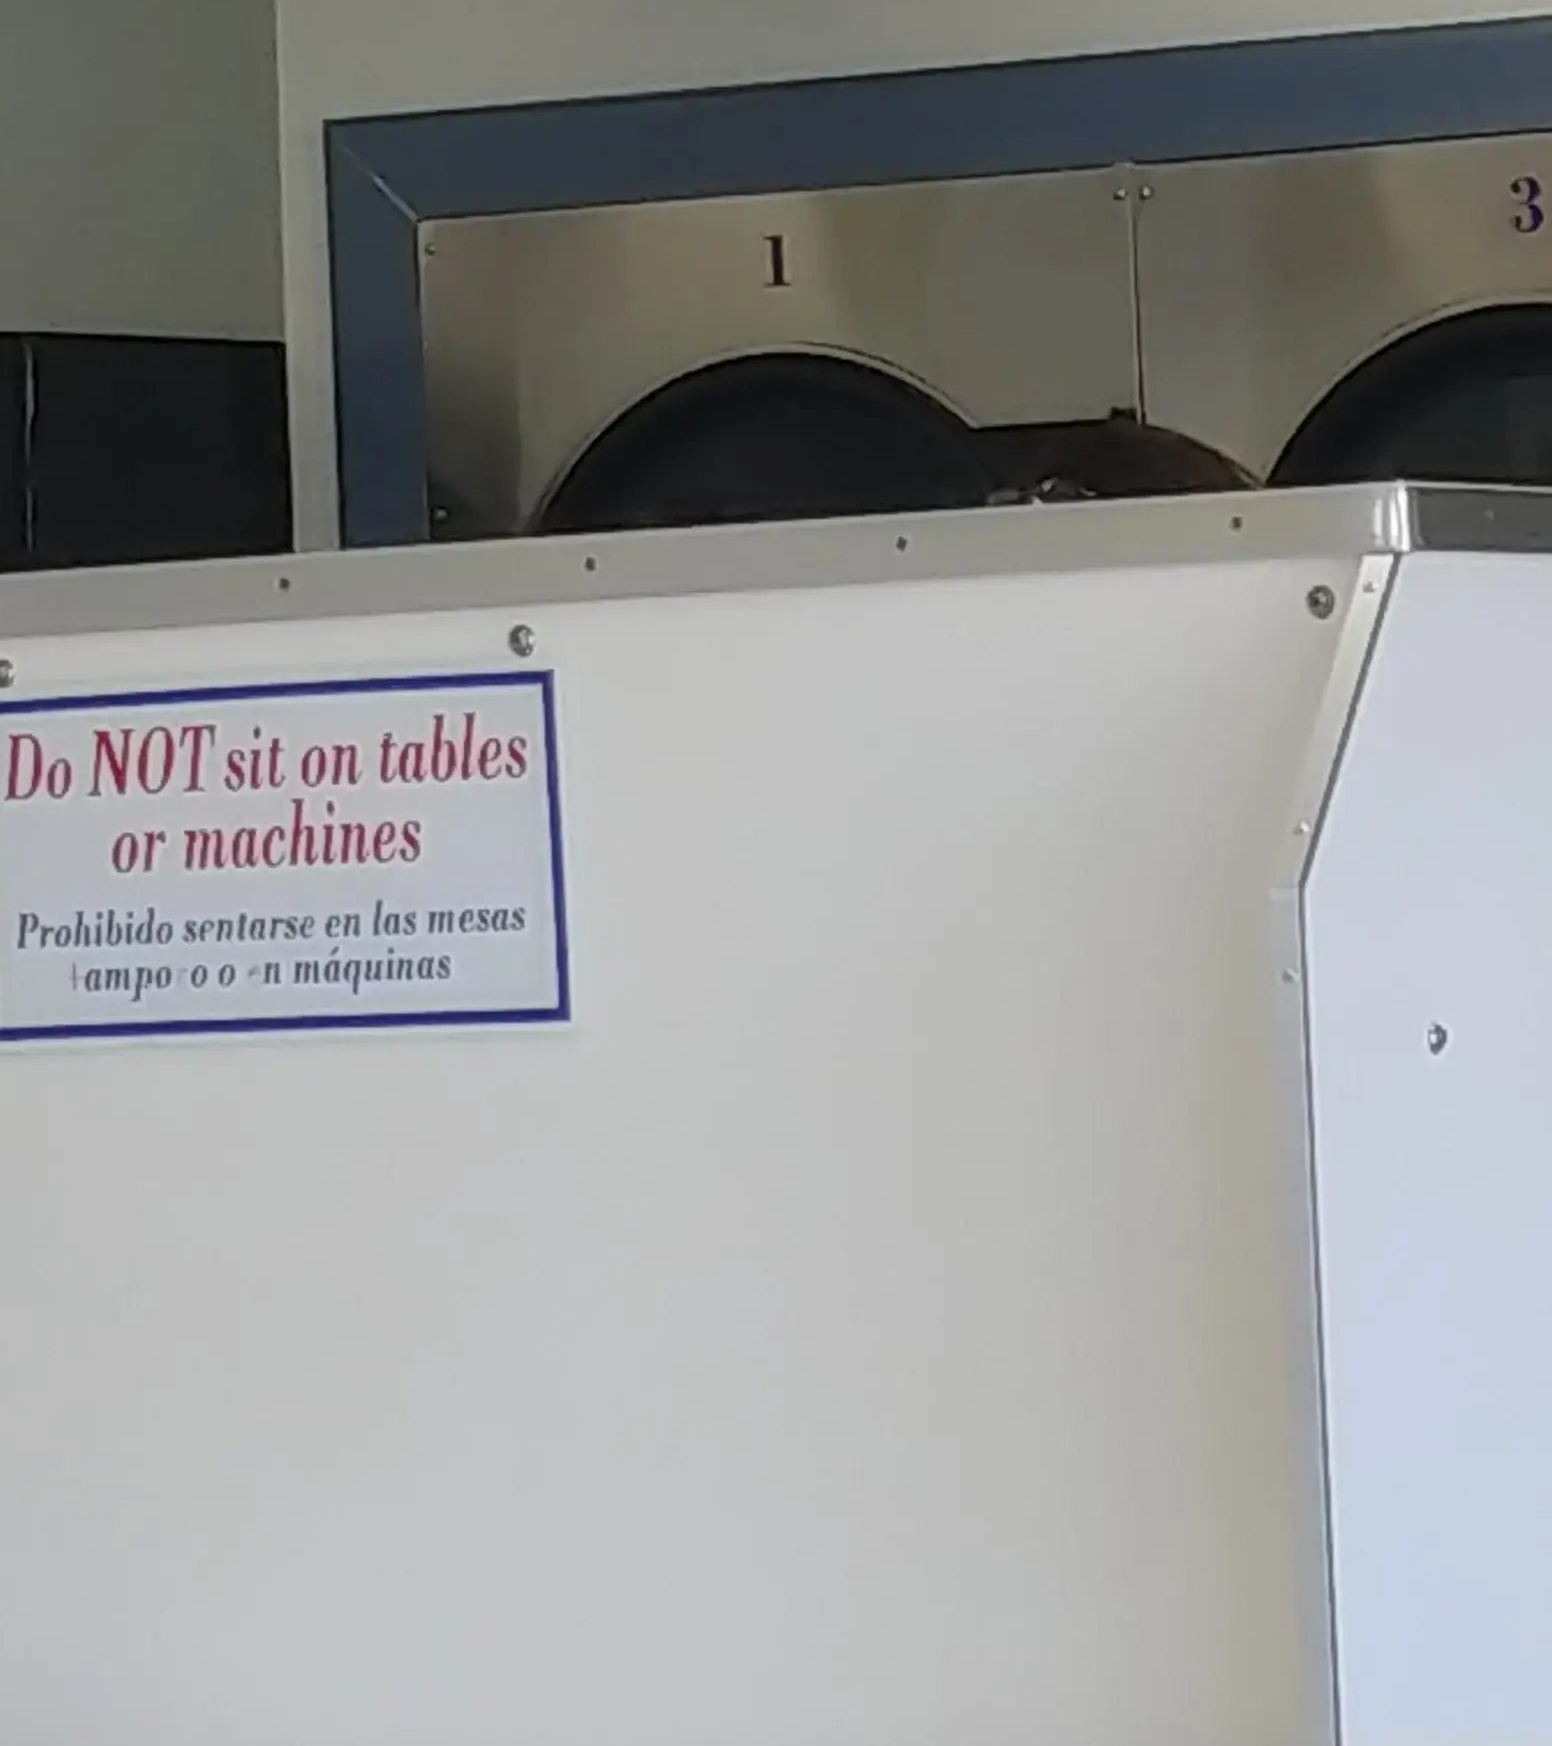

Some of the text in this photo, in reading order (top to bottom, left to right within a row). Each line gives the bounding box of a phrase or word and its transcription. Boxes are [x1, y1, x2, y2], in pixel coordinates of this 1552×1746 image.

[1510, 175, 1545, 234] 3
[762, 233, 792, 289] 1
[3, 712, 529, 801] Do NOT sit on tables
[111, 798, 423, 874] or machines
[16, 899, 526, 951] Prohibido sentarse en las mesas
[70, 962, 209, 1003] tampoo
[217, 963, 237, 987] o
[292, 946, 451, 995] máquinas
